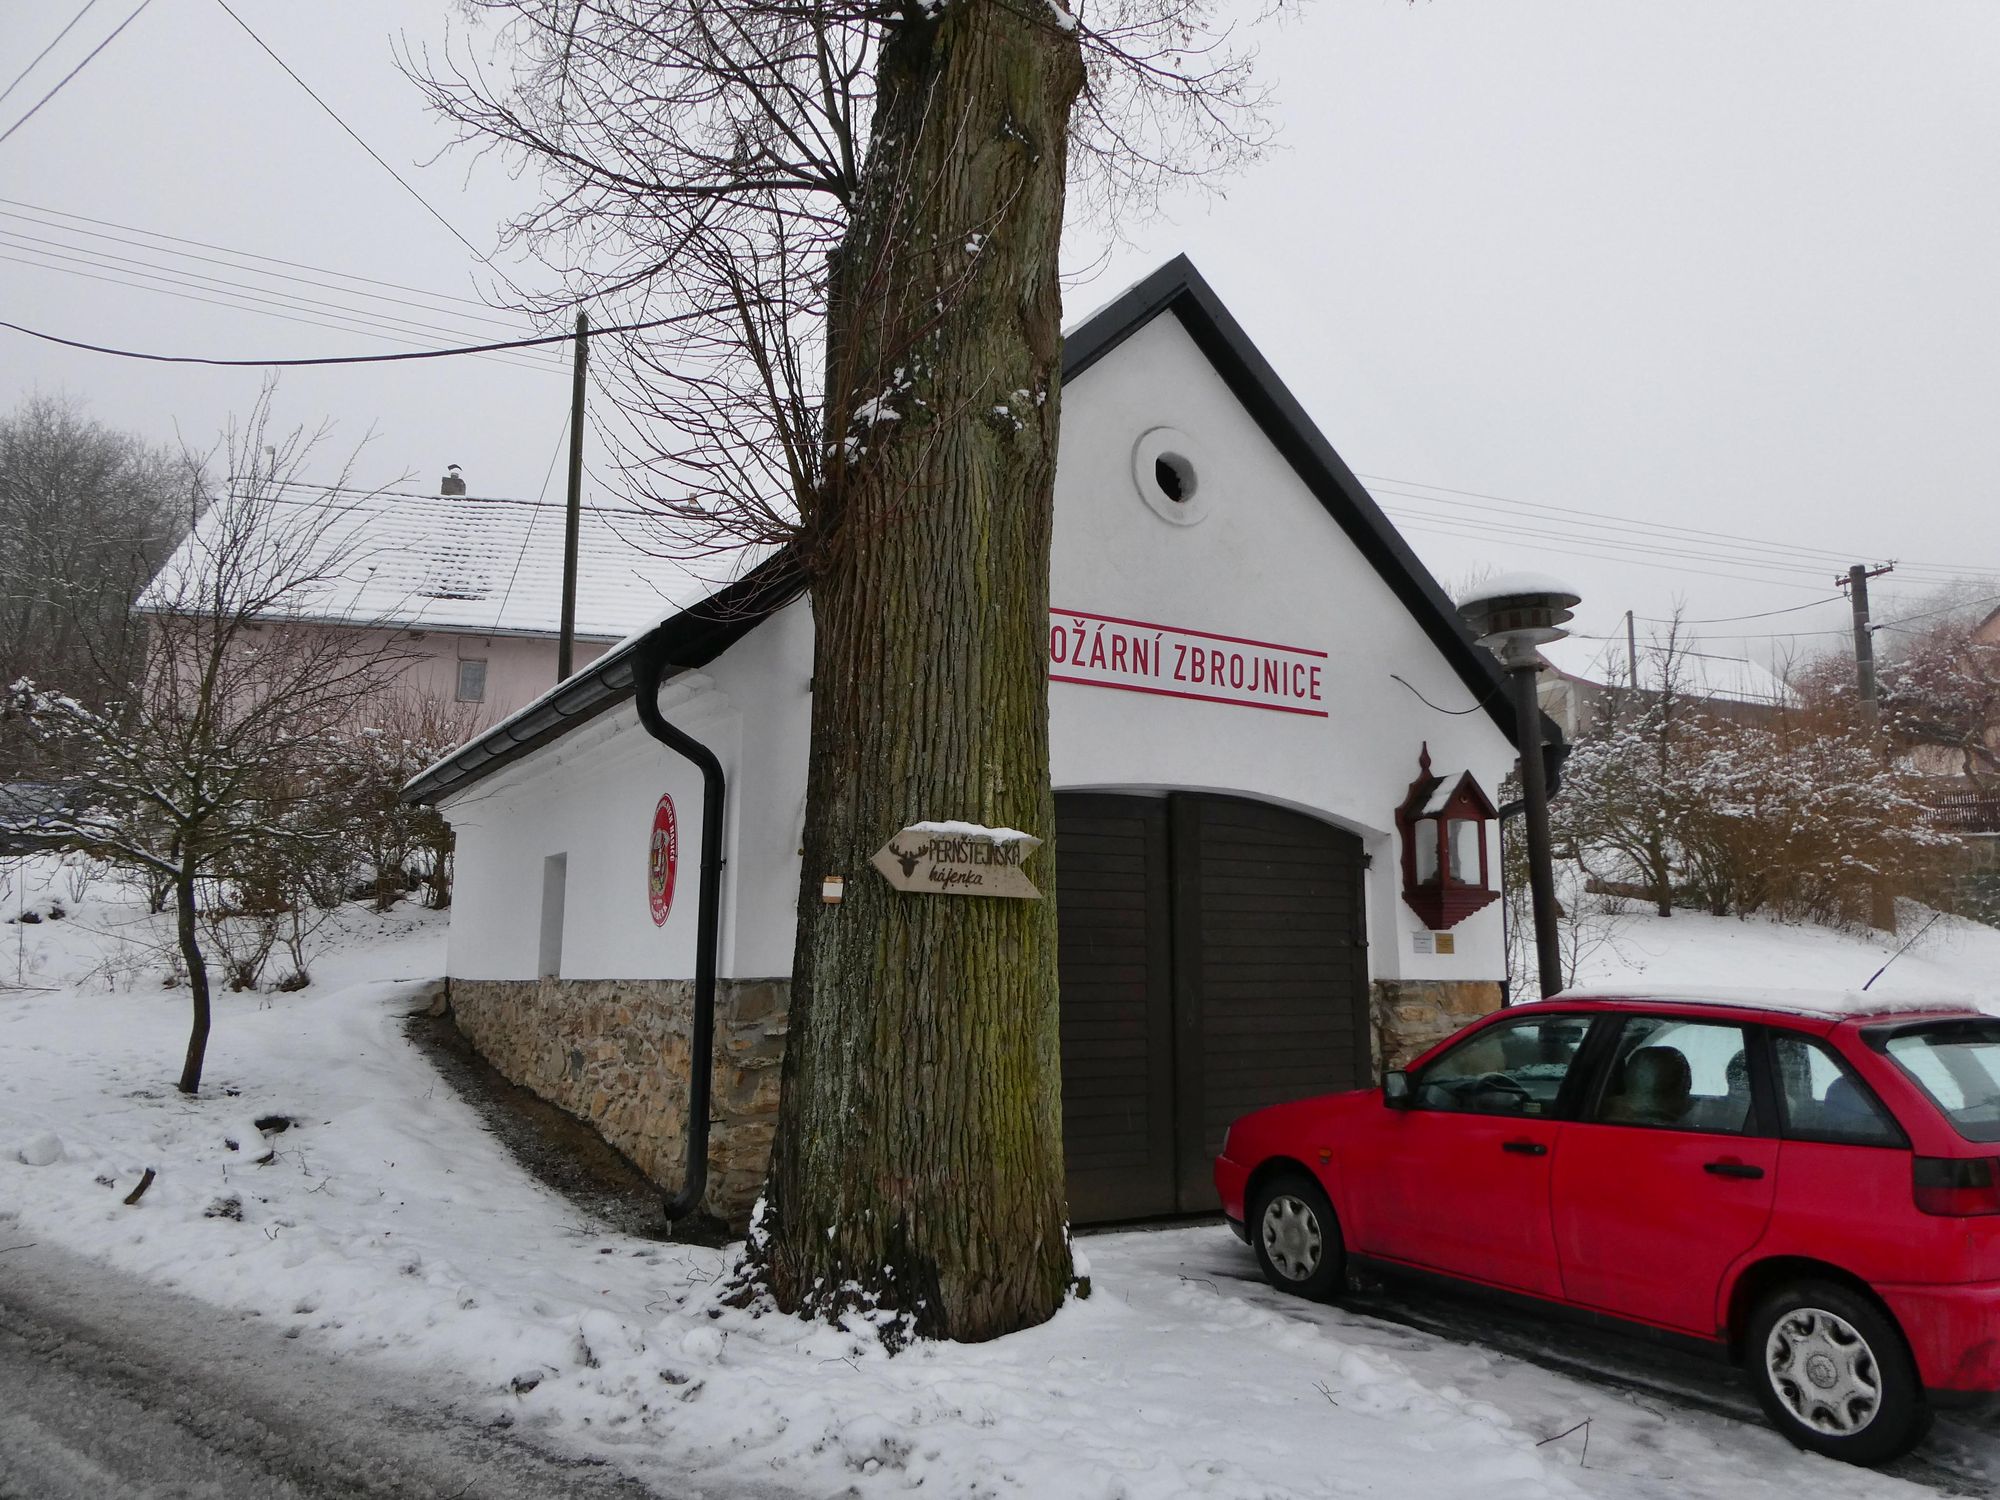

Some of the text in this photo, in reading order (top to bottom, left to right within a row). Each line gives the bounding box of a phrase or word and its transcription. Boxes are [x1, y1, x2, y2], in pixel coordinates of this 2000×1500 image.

[1049, 619, 1322, 700] OŽÁRNÍ ZBROJNICE
[929, 865, 984, 890] hájenka
